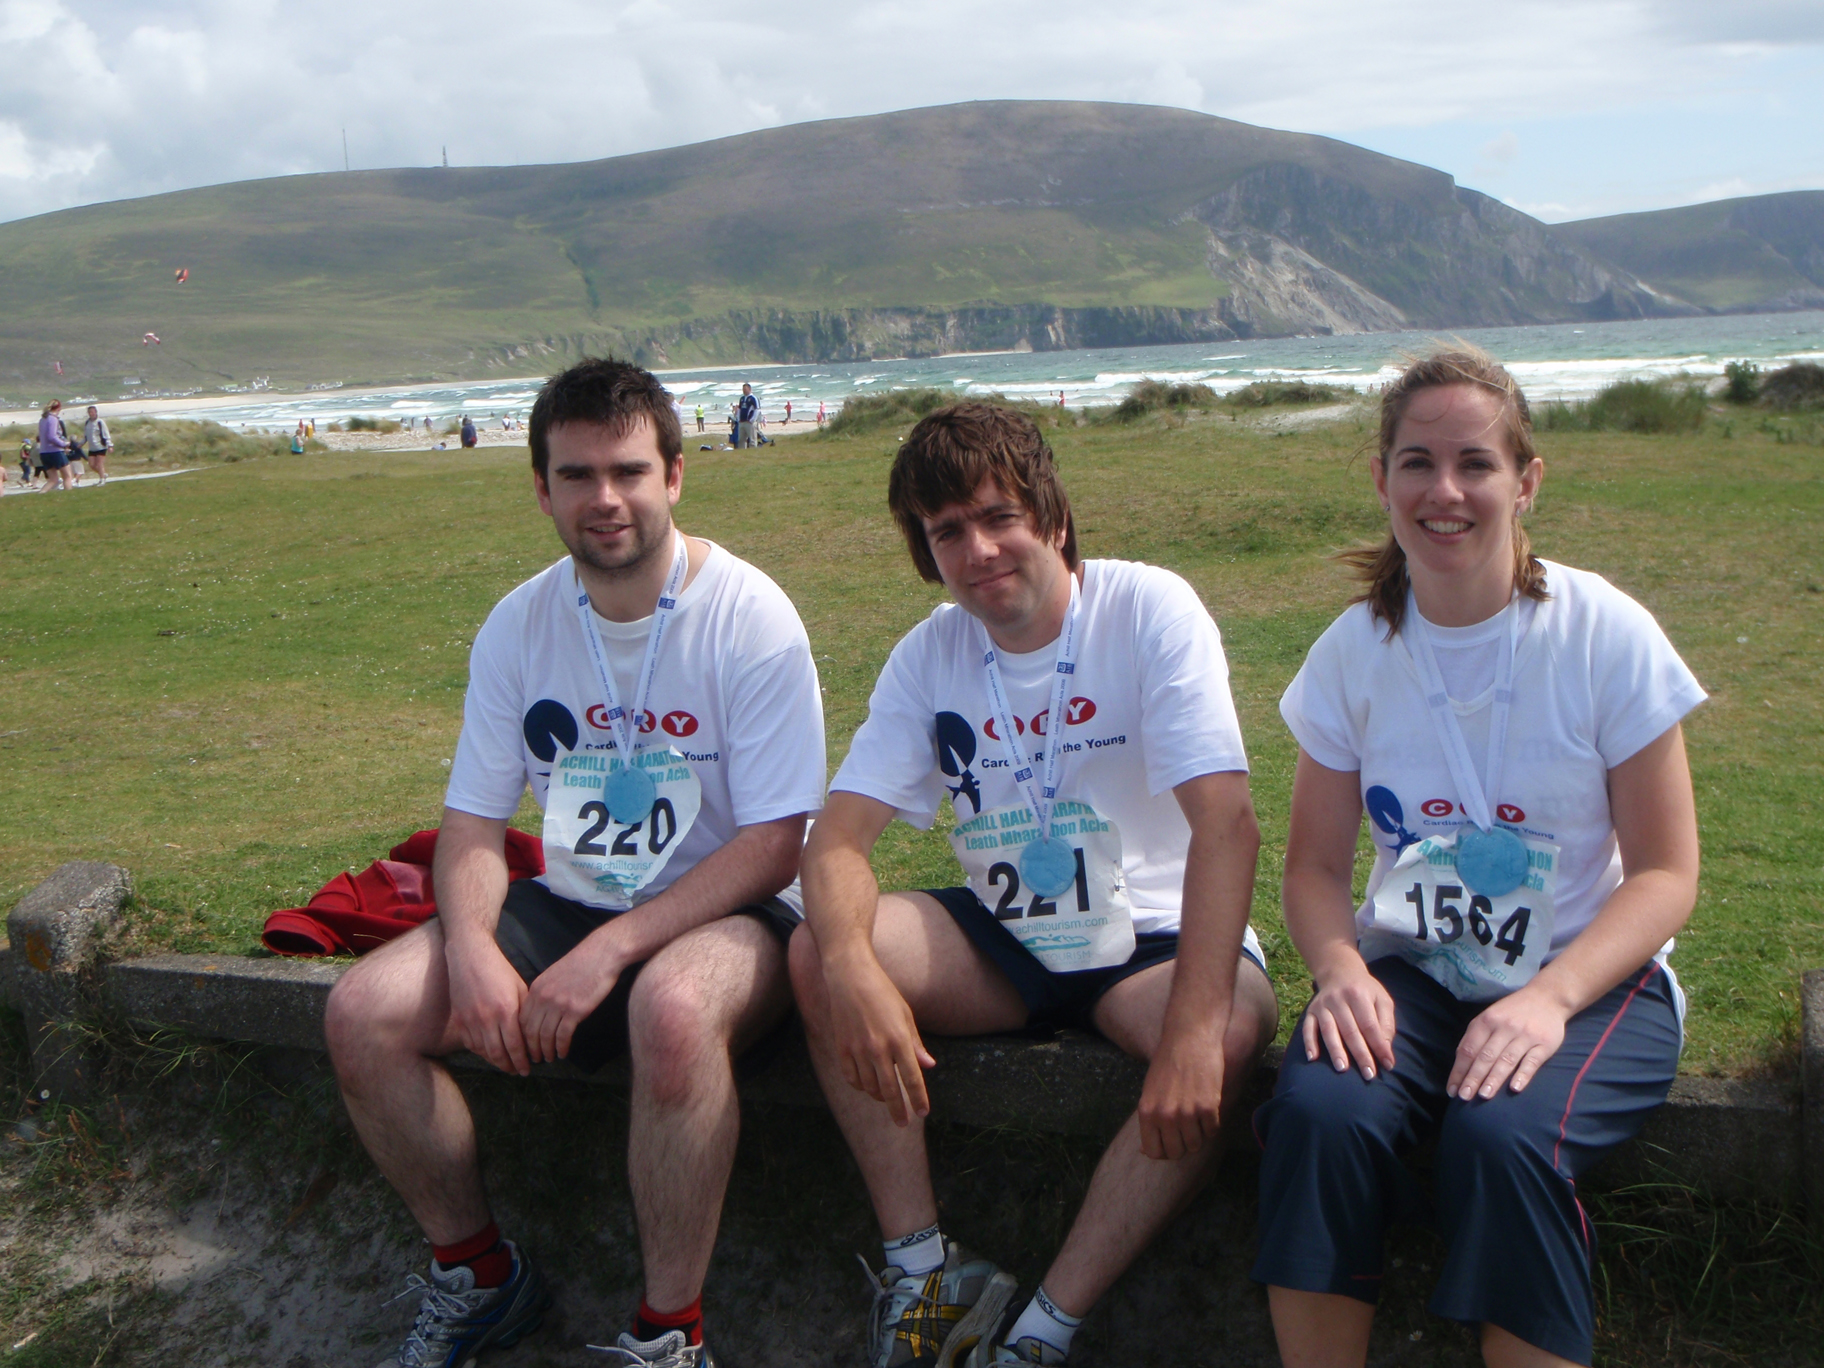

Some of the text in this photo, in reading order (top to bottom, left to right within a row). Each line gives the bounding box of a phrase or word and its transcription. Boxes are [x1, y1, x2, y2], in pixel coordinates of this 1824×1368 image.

[1063, 742, 1082, 753] the
[1085, 735, 1126, 749] Young
[559, 755, 606, 772] ACHILL
[683, 750, 719, 762] Young
[563, 772, 601, 789] Leath
[665, 766, 691, 782] Acla
[1425, 800, 1521, 821] CY
[573, 797, 677, 857] 220
[953, 814, 998, 837] ACHILL
[964, 834, 998, 850] Leath
[1079, 817, 1109, 834] Acla
[1521, 827, 1555, 840] Young
[1404, 881, 1532, 967] 1564
